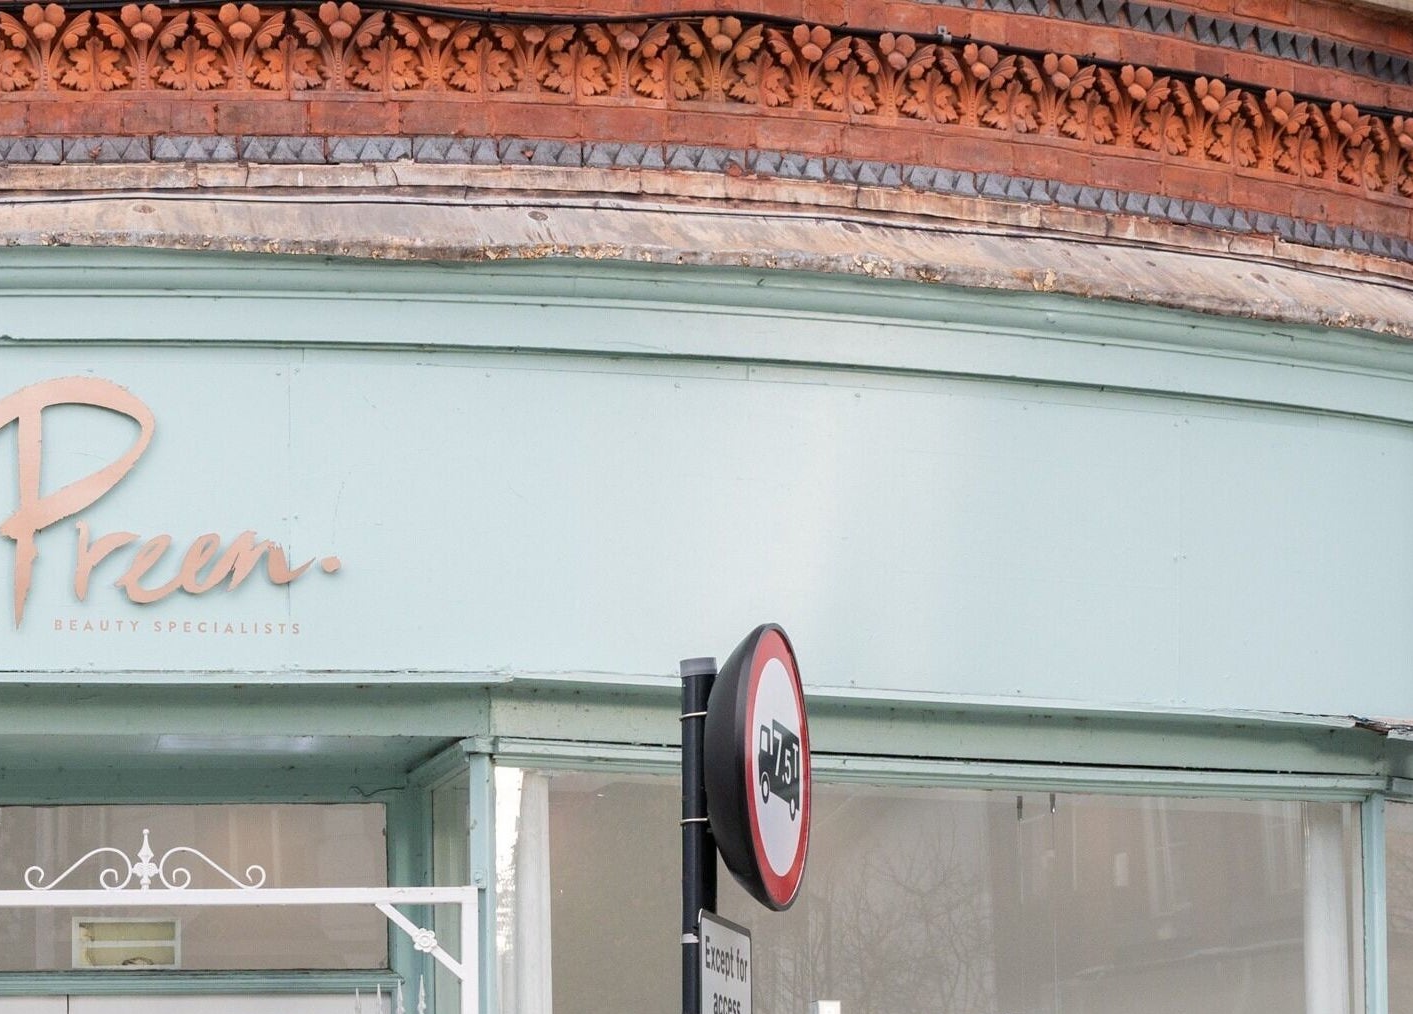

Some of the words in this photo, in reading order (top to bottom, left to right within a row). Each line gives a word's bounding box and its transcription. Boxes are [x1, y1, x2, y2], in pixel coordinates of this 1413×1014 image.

[53, 618, 140, 632] BEAUTY
[153, 620, 301, 635] SPECIALISTS
[773, 729, 799, 785] 7.5T
[705, 935, 735, 982] Except
[736, 947, 748, 984] for
